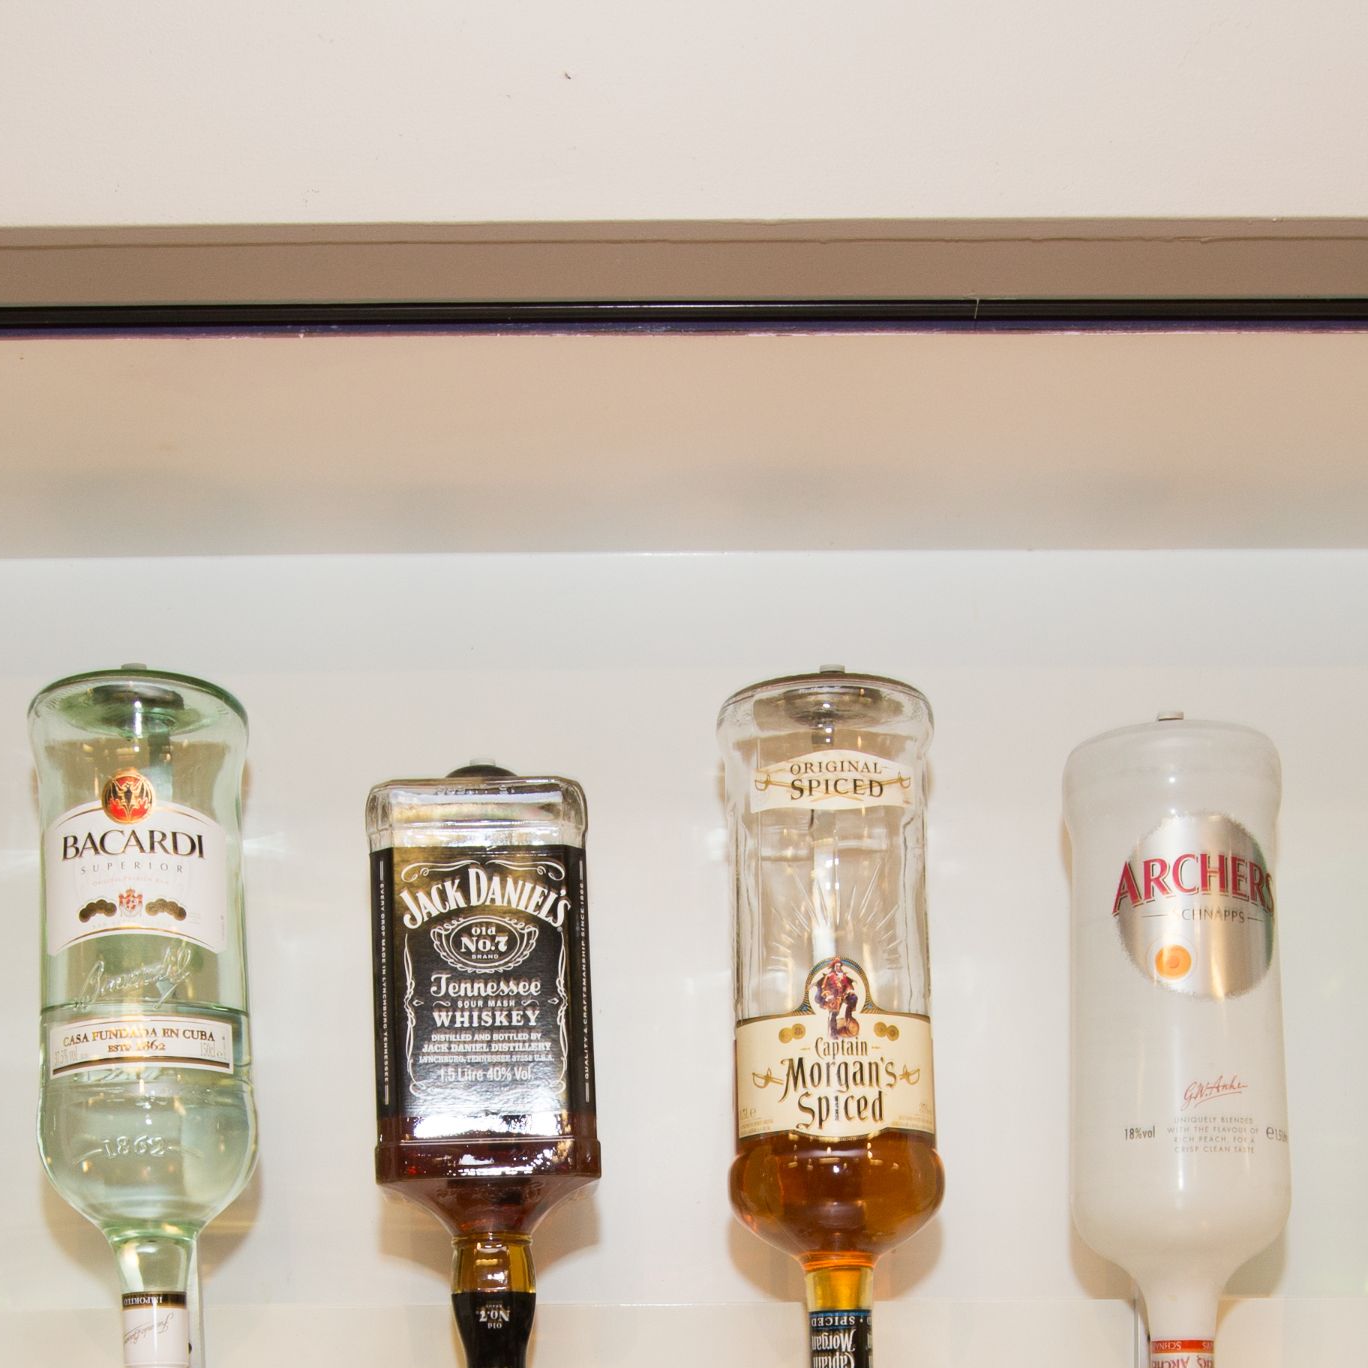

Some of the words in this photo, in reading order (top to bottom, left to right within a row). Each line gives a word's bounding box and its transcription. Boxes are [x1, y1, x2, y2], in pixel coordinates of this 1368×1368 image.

[789, 759, 883, 776] ORIGINAL
[789, 778, 884, 801] SPICED
[62, 829, 206, 862] BACARDI
[80, 861, 184, 875] SUPERIOR
[1111, 852, 1275, 918] ARCHERS
[399, 875, 468, 930] JACK
[468, 867, 572, 928] DANIEL'S
[1170, 907, 1246, 924] SCHNAPPS
[471, 926, 497, 936] Old
[460, 935, 509, 953] No.7
[430, 973, 542, 998] Tennessee
[457, 1000, 484, 1009] SOUR
[487, 1000, 516, 1008] MASH
[432, 1010, 541, 1028] WHISKEY
[63, 1033, 89, 1047] CASA
[162, 1027, 180, 1039] EN
[182, 1028, 215, 1042] CUBA
[431, 1033, 473, 1042] DISTILLED
[473, 1033, 491, 1041] AND
[492, 1033, 528, 1041] BOTTLED
[530, 1032, 542, 1040] BY
[421, 1043, 449, 1053] JACK
[450, 1043, 490, 1053] DANIEL
[490, 1042, 552, 1052] DISTILLERY
[814, 1036, 869, 1060] Captain
[456, 1066, 484, 1081] Litre
[486, 1066, 512, 1081] 40%
[778, 1056, 898, 1103] Morgan's
[795, 1090, 886, 1130] Spiced
[810, 1315, 856, 1327] SPICED
[811, 1328, 856, 1352] Morgan
